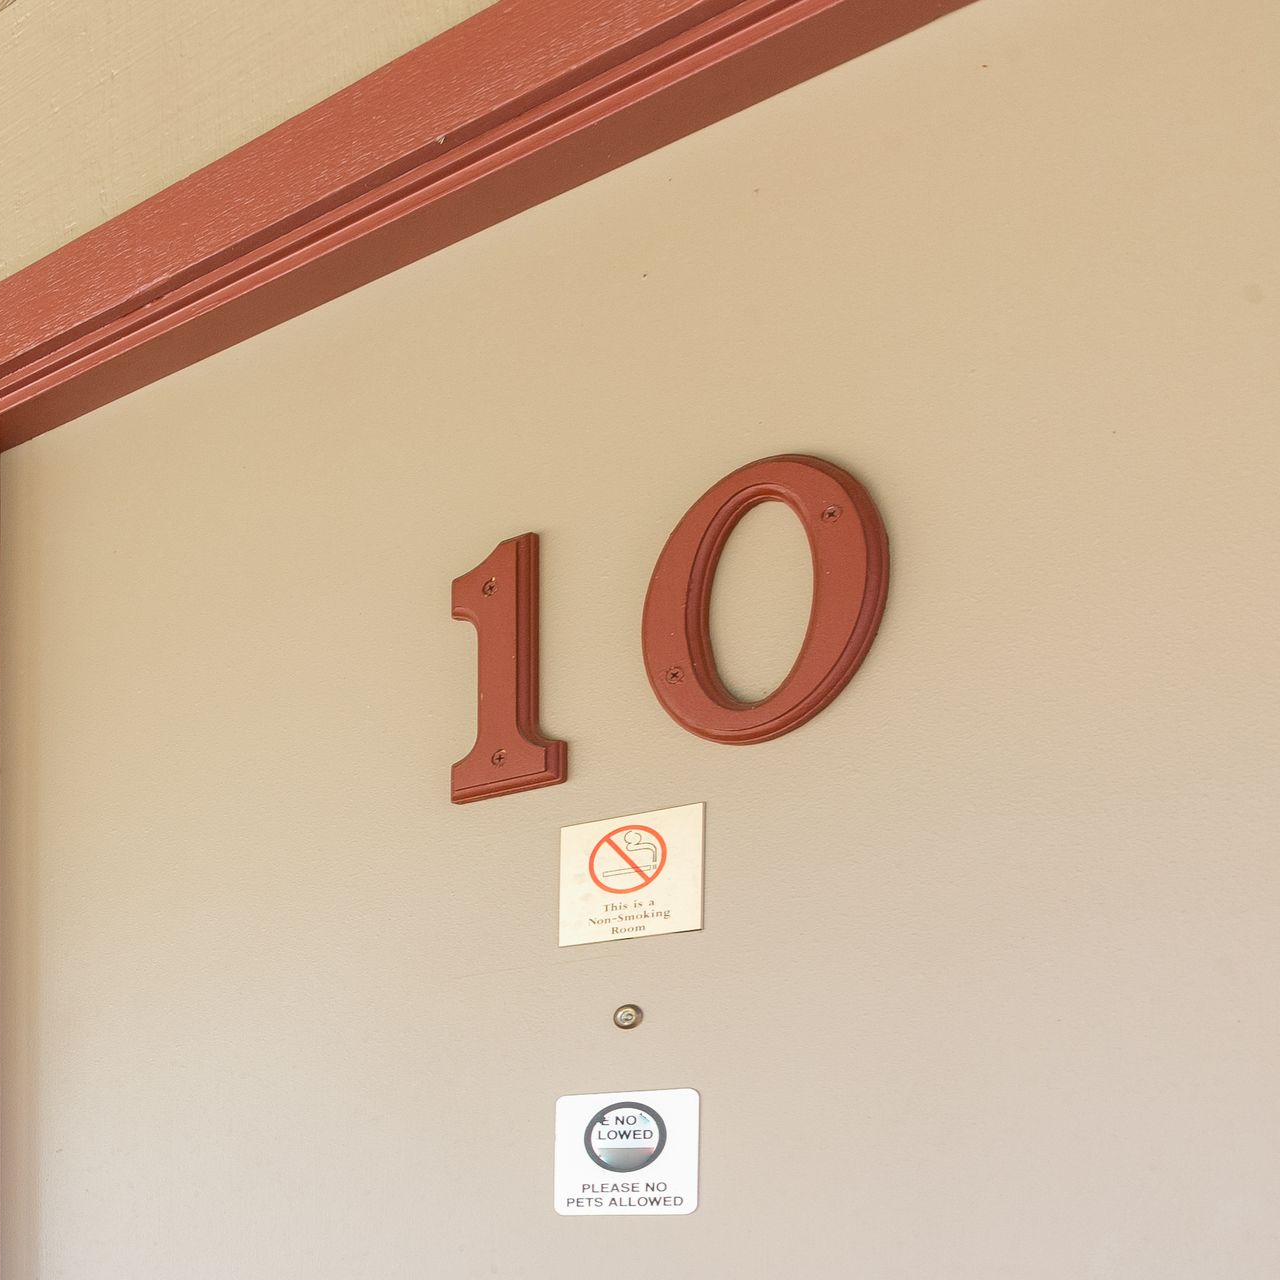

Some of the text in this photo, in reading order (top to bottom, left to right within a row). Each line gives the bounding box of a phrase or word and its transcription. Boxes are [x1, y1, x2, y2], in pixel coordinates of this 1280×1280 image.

[451, 453, 890, 805] 10
[603, 902, 628, 913] This
[633, 899, 643, 908] is
[588, 909, 671, 926] Non-Smoking
[611, 924, 646, 935] Room
[615, 1115, 637, 1126] NO
[598, 1129, 653, 1140] LOWED
[581, 1181, 667, 1193] PLEASE NO
[566, 1196, 684, 1207] PETS ALLOWED
